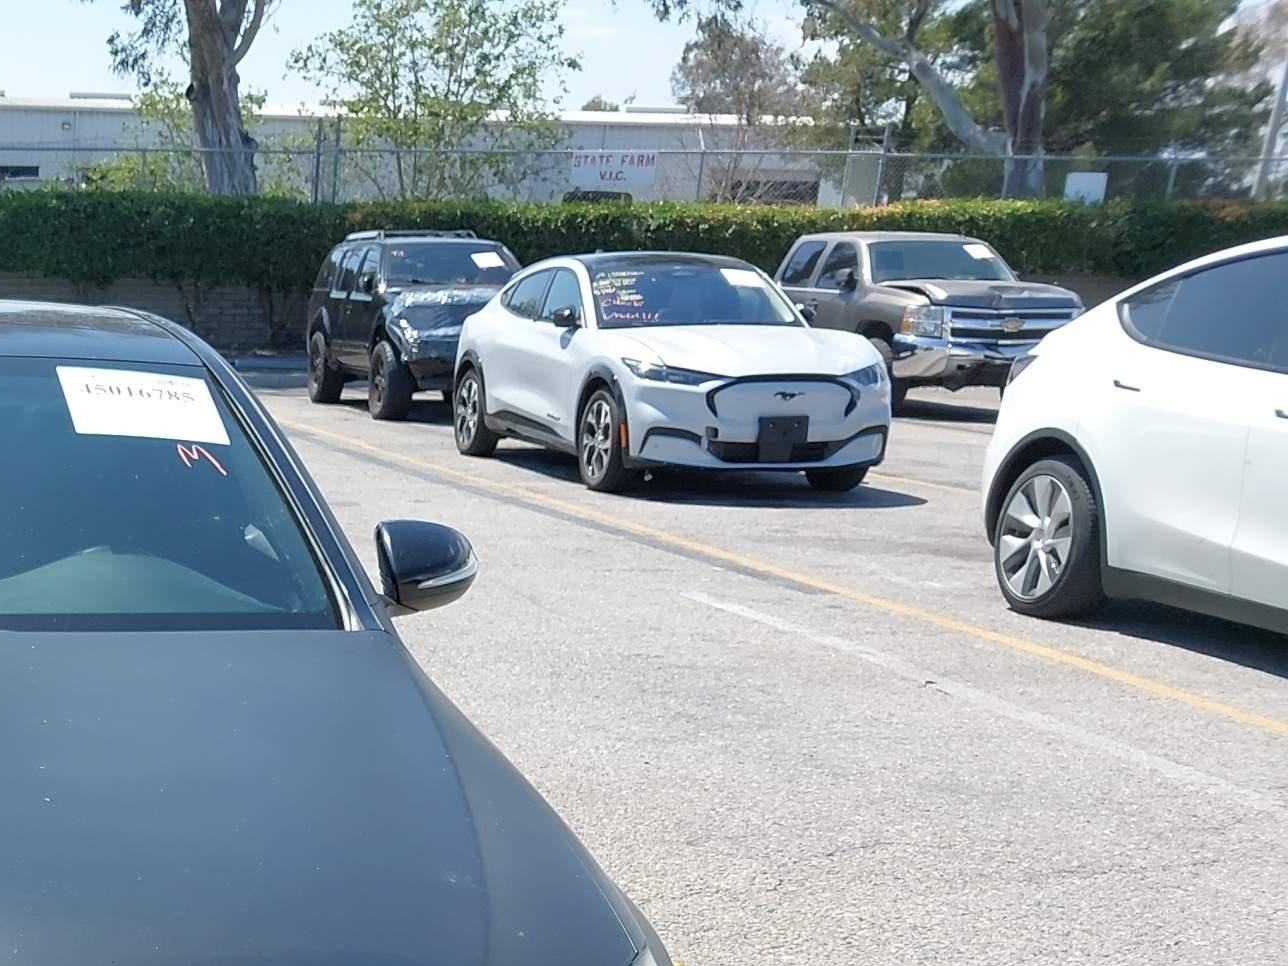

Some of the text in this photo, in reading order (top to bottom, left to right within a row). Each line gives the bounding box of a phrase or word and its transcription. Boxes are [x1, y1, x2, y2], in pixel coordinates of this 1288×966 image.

[621, 154, 656, 168] FARM
[599, 170, 628, 181] V.I.C.
[176, 443, 228, 476] M
